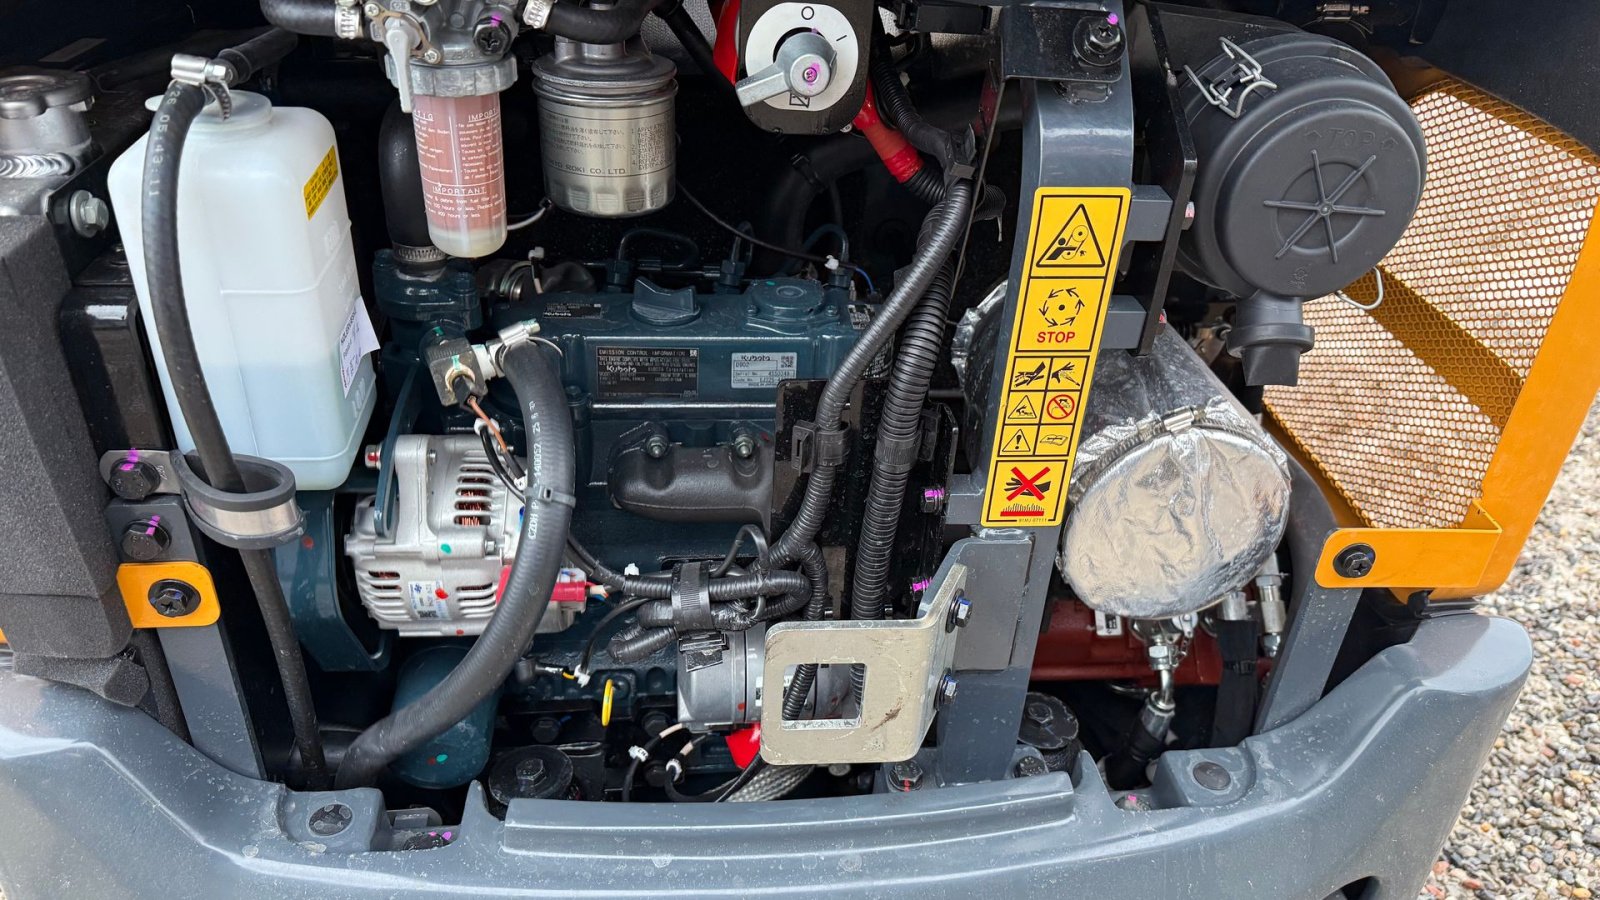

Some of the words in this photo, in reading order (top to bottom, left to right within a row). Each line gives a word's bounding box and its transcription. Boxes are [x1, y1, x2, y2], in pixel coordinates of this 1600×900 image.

[1327, 127, 1376, 149] TOP
[433, 186, 486, 195] IMPORTANT
[1036, 331, 1076, 344] STOP
[606, 365, 637, 373] Kubota
